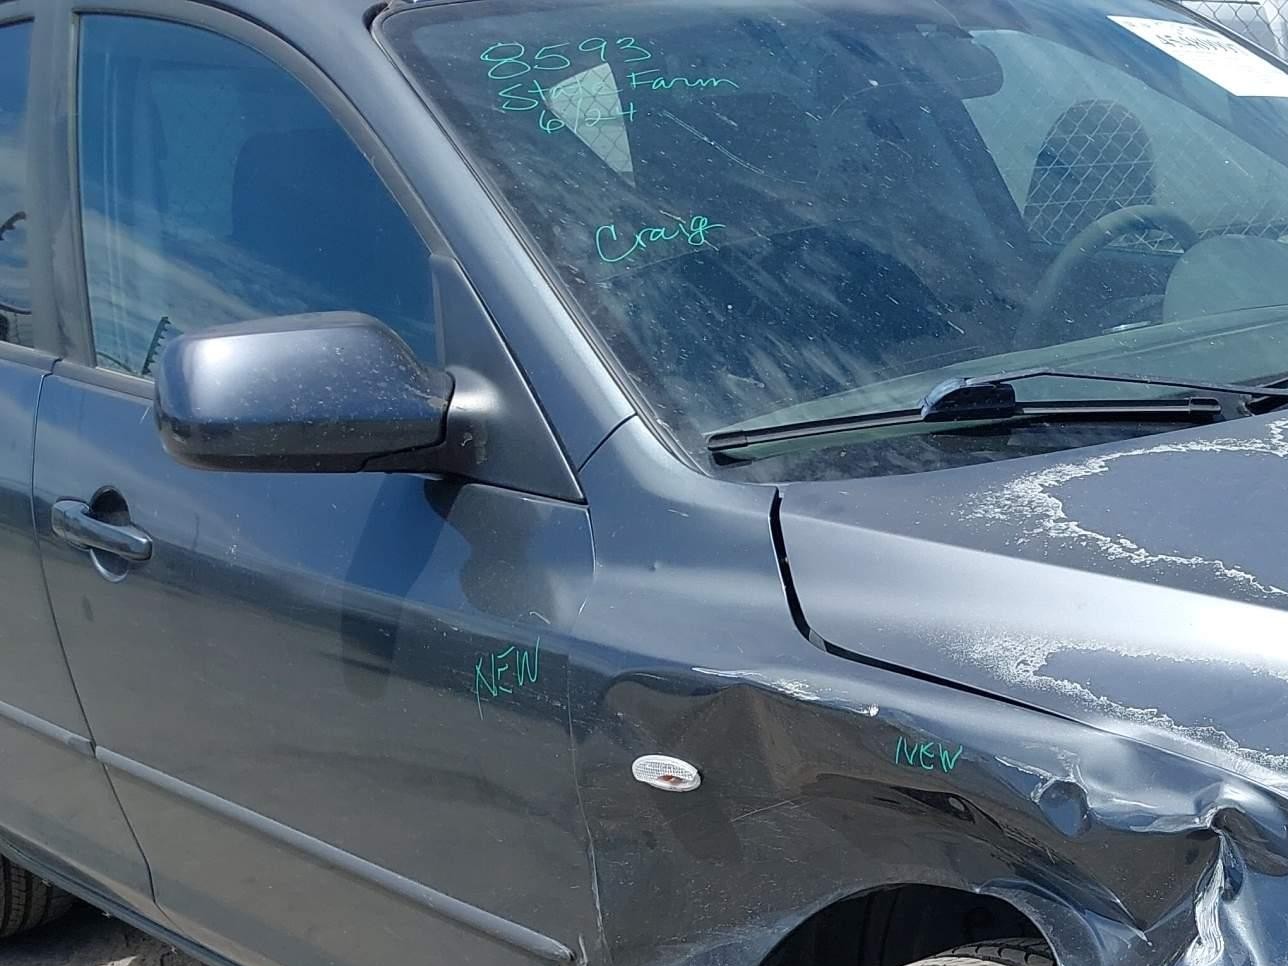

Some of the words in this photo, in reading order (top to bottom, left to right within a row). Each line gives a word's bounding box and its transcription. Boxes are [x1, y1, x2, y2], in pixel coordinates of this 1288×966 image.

[480, 37, 652, 80] 8593
[498, 79, 623, 111] State
[625, 69, 741, 90] Farm
[538, 102, 638, 134] 6/24
[595, 214, 728, 262] Craig
[475, 635, 541, 708] NEW
[895, 735, 963, 774] NEW
